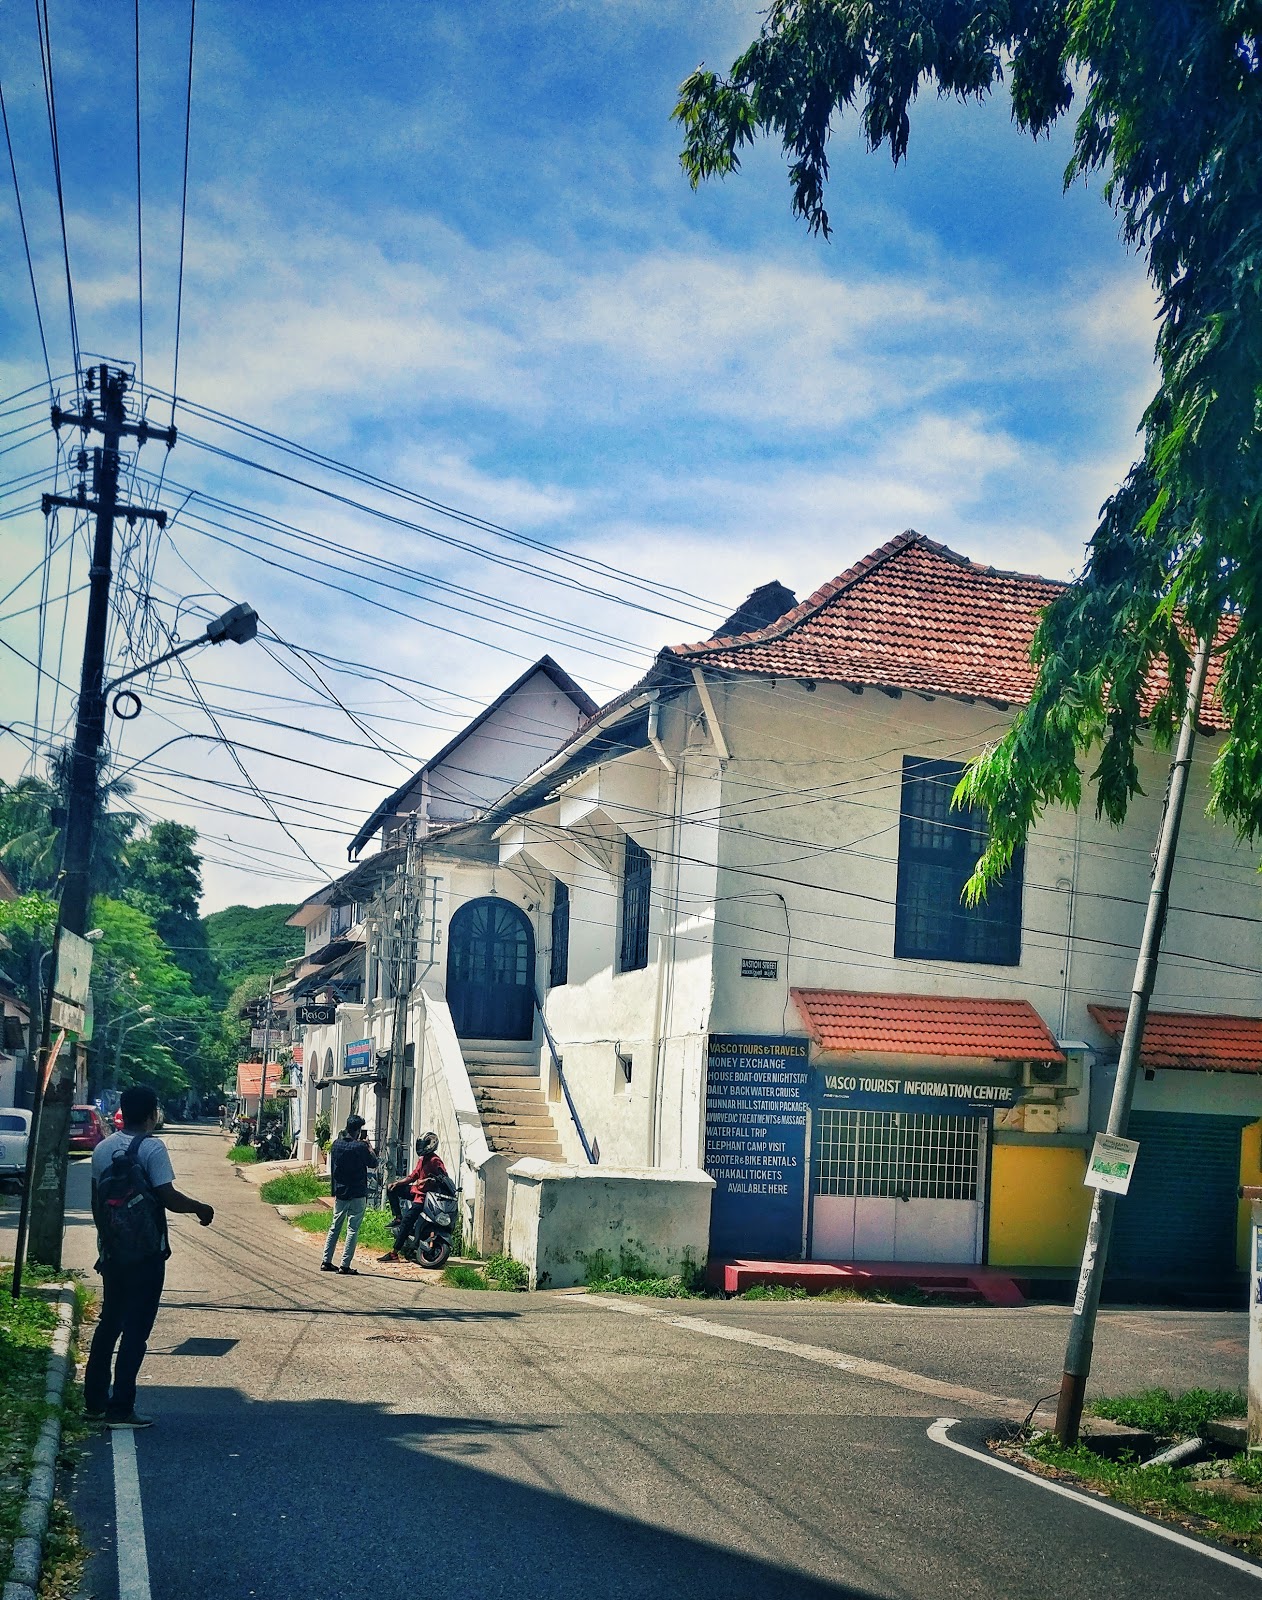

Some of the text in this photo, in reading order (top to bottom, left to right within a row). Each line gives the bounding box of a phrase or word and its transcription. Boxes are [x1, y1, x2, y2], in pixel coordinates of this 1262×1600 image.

[762, 961, 777, 970] STREET
[709, 1043, 738, 1054] VASCO
[709, 1057, 786, 1069] MONEY EXCHANGE
[707, 1084, 728, 1095] DAILY
[775, 1087, 800, 1098] CRUISE
[825, 1075, 1013, 1101] VASCO TOURIST INFORMATION CENTRE
[706, 1098, 736, 1109] MUNNAR
[706, 1112, 738, 1123] AYURVEDIC
[751, 1127, 767, 1138] TRIP
[707, 1140, 786, 1153] ELEPHANT CAMP VISIT
[762, 1156, 797, 1167] RENTALS
[749, 1169, 782, 1180] TICKETS
[728, 1183, 788, 1194] AVAILABLE HERE
